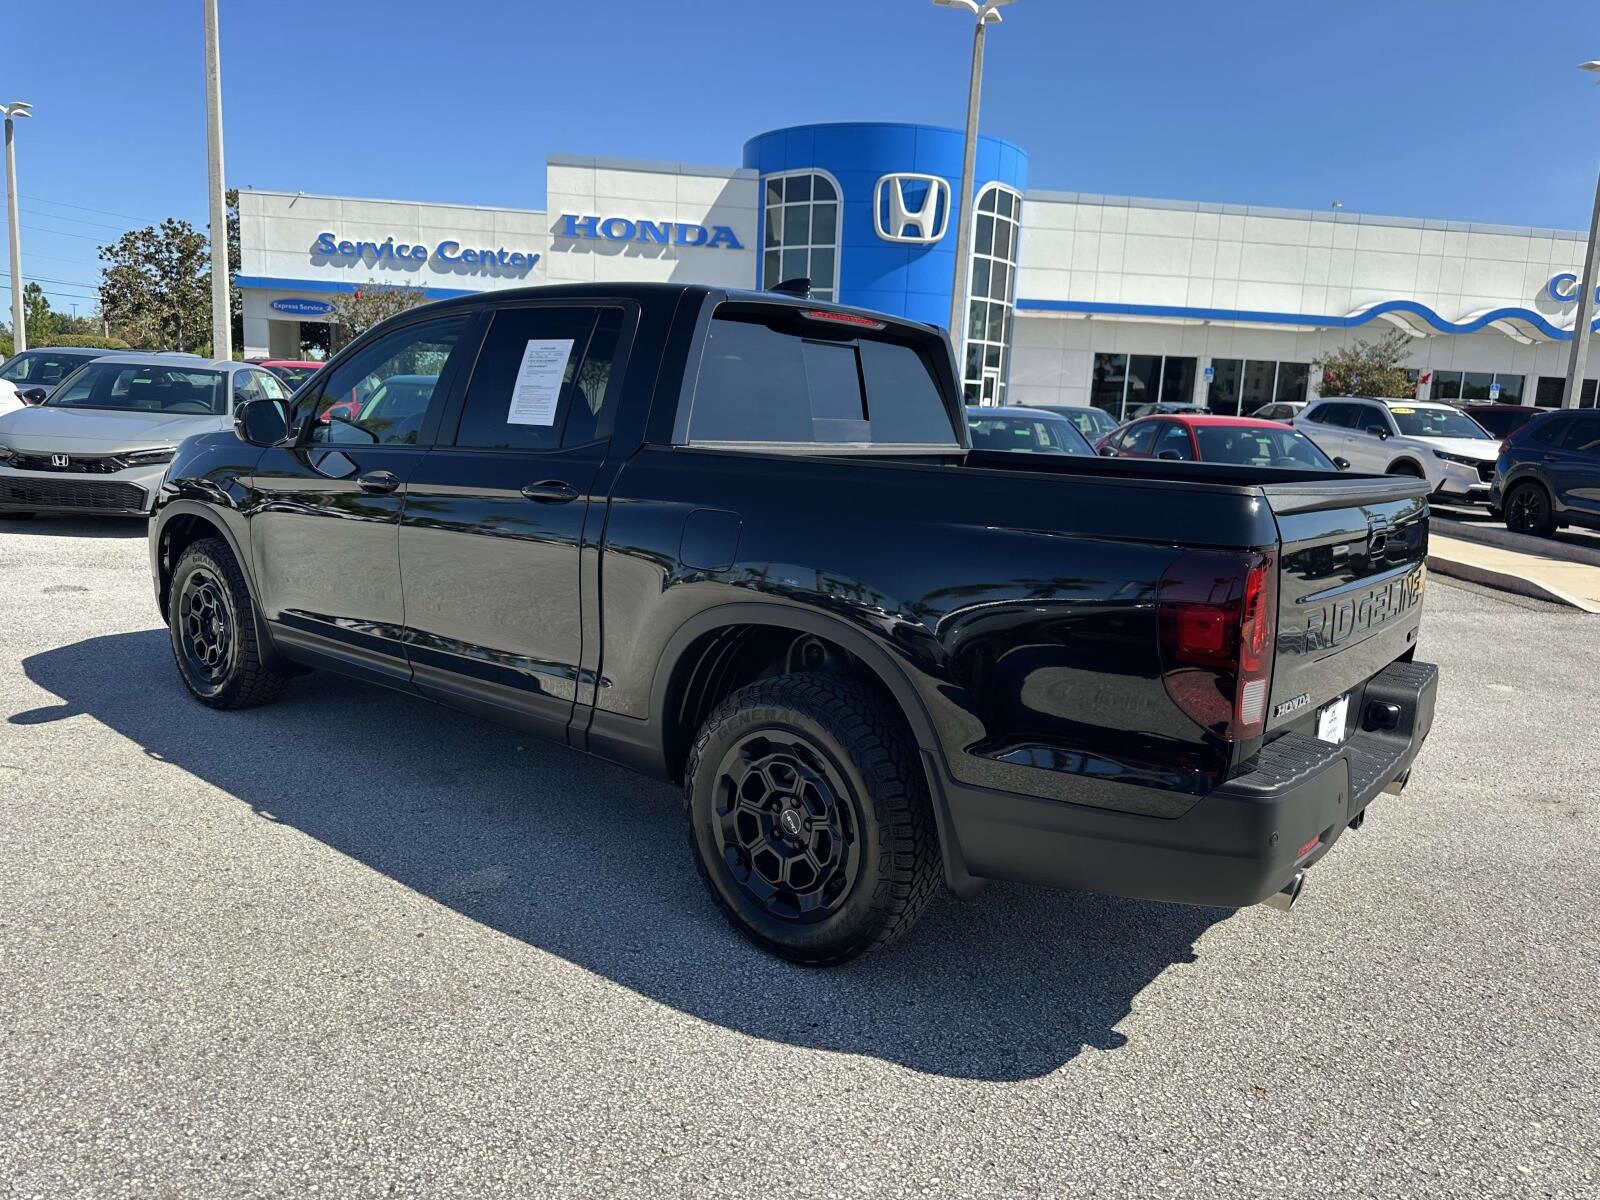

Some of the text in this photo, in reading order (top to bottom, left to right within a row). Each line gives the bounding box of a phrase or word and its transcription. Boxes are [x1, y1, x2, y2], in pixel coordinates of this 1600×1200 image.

[562, 214, 744, 249] HONDA
[318, 232, 541, 269] Service Center
[273, 302, 324, 311] Express Service
[1301, 568, 1422, 656] RIDGELINE
[1274, 692, 1310, 717] HONDA
